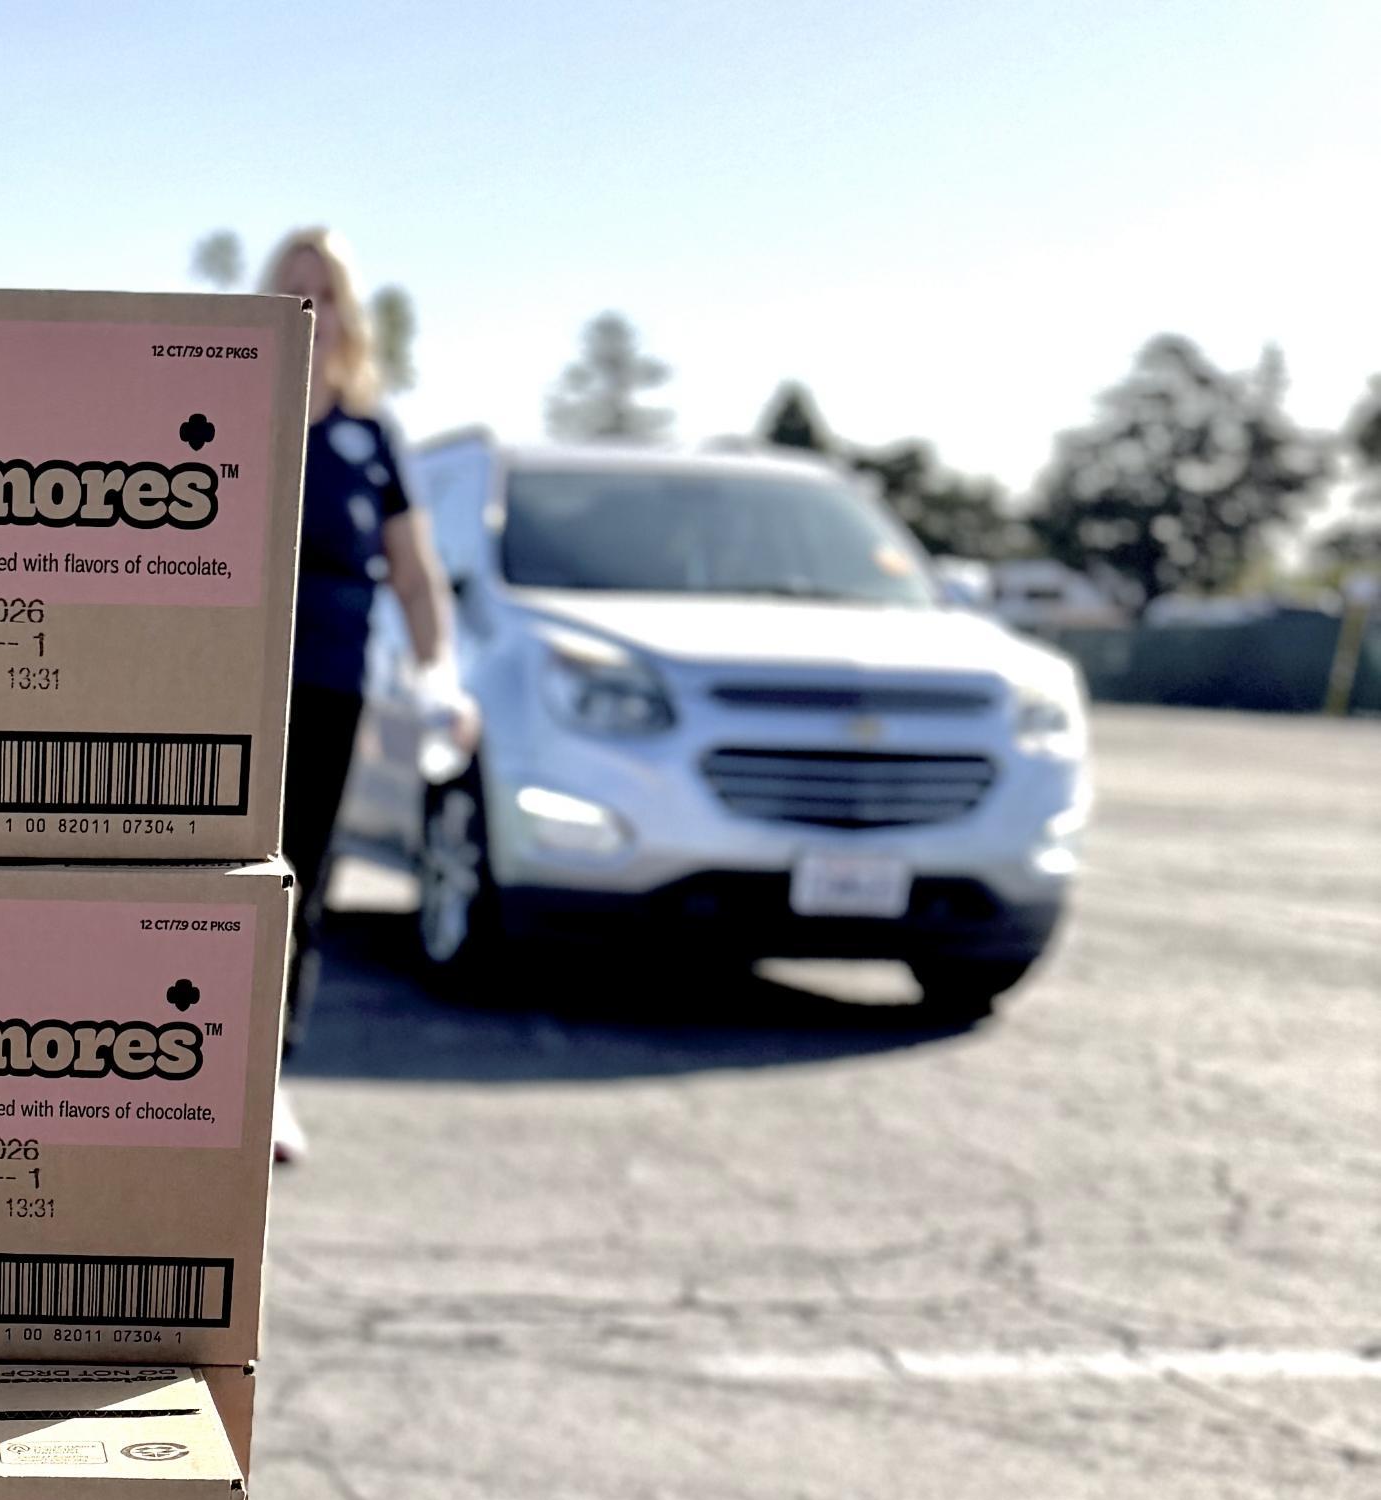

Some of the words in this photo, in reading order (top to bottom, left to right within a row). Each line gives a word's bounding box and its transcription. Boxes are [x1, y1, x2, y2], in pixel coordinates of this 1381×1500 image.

[152, 346, 164, 356] 12
[206, 347, 223, 358] OZ
[226, 348, 258, 359] PKGS
[34, 632, 44, 656] 1
[8, 668, 58, 690] 13:31
[6, 818, 12, 832] 1
[26, 818, 45, 832] 00
[58, 819, 108, 833] 82011
[123, 820, 173, 834] 07304
[190, 820, 194, 834] 1
[29, 1168, 40, 1188] 1
[6, 1198, 54, 1218] 13:31
